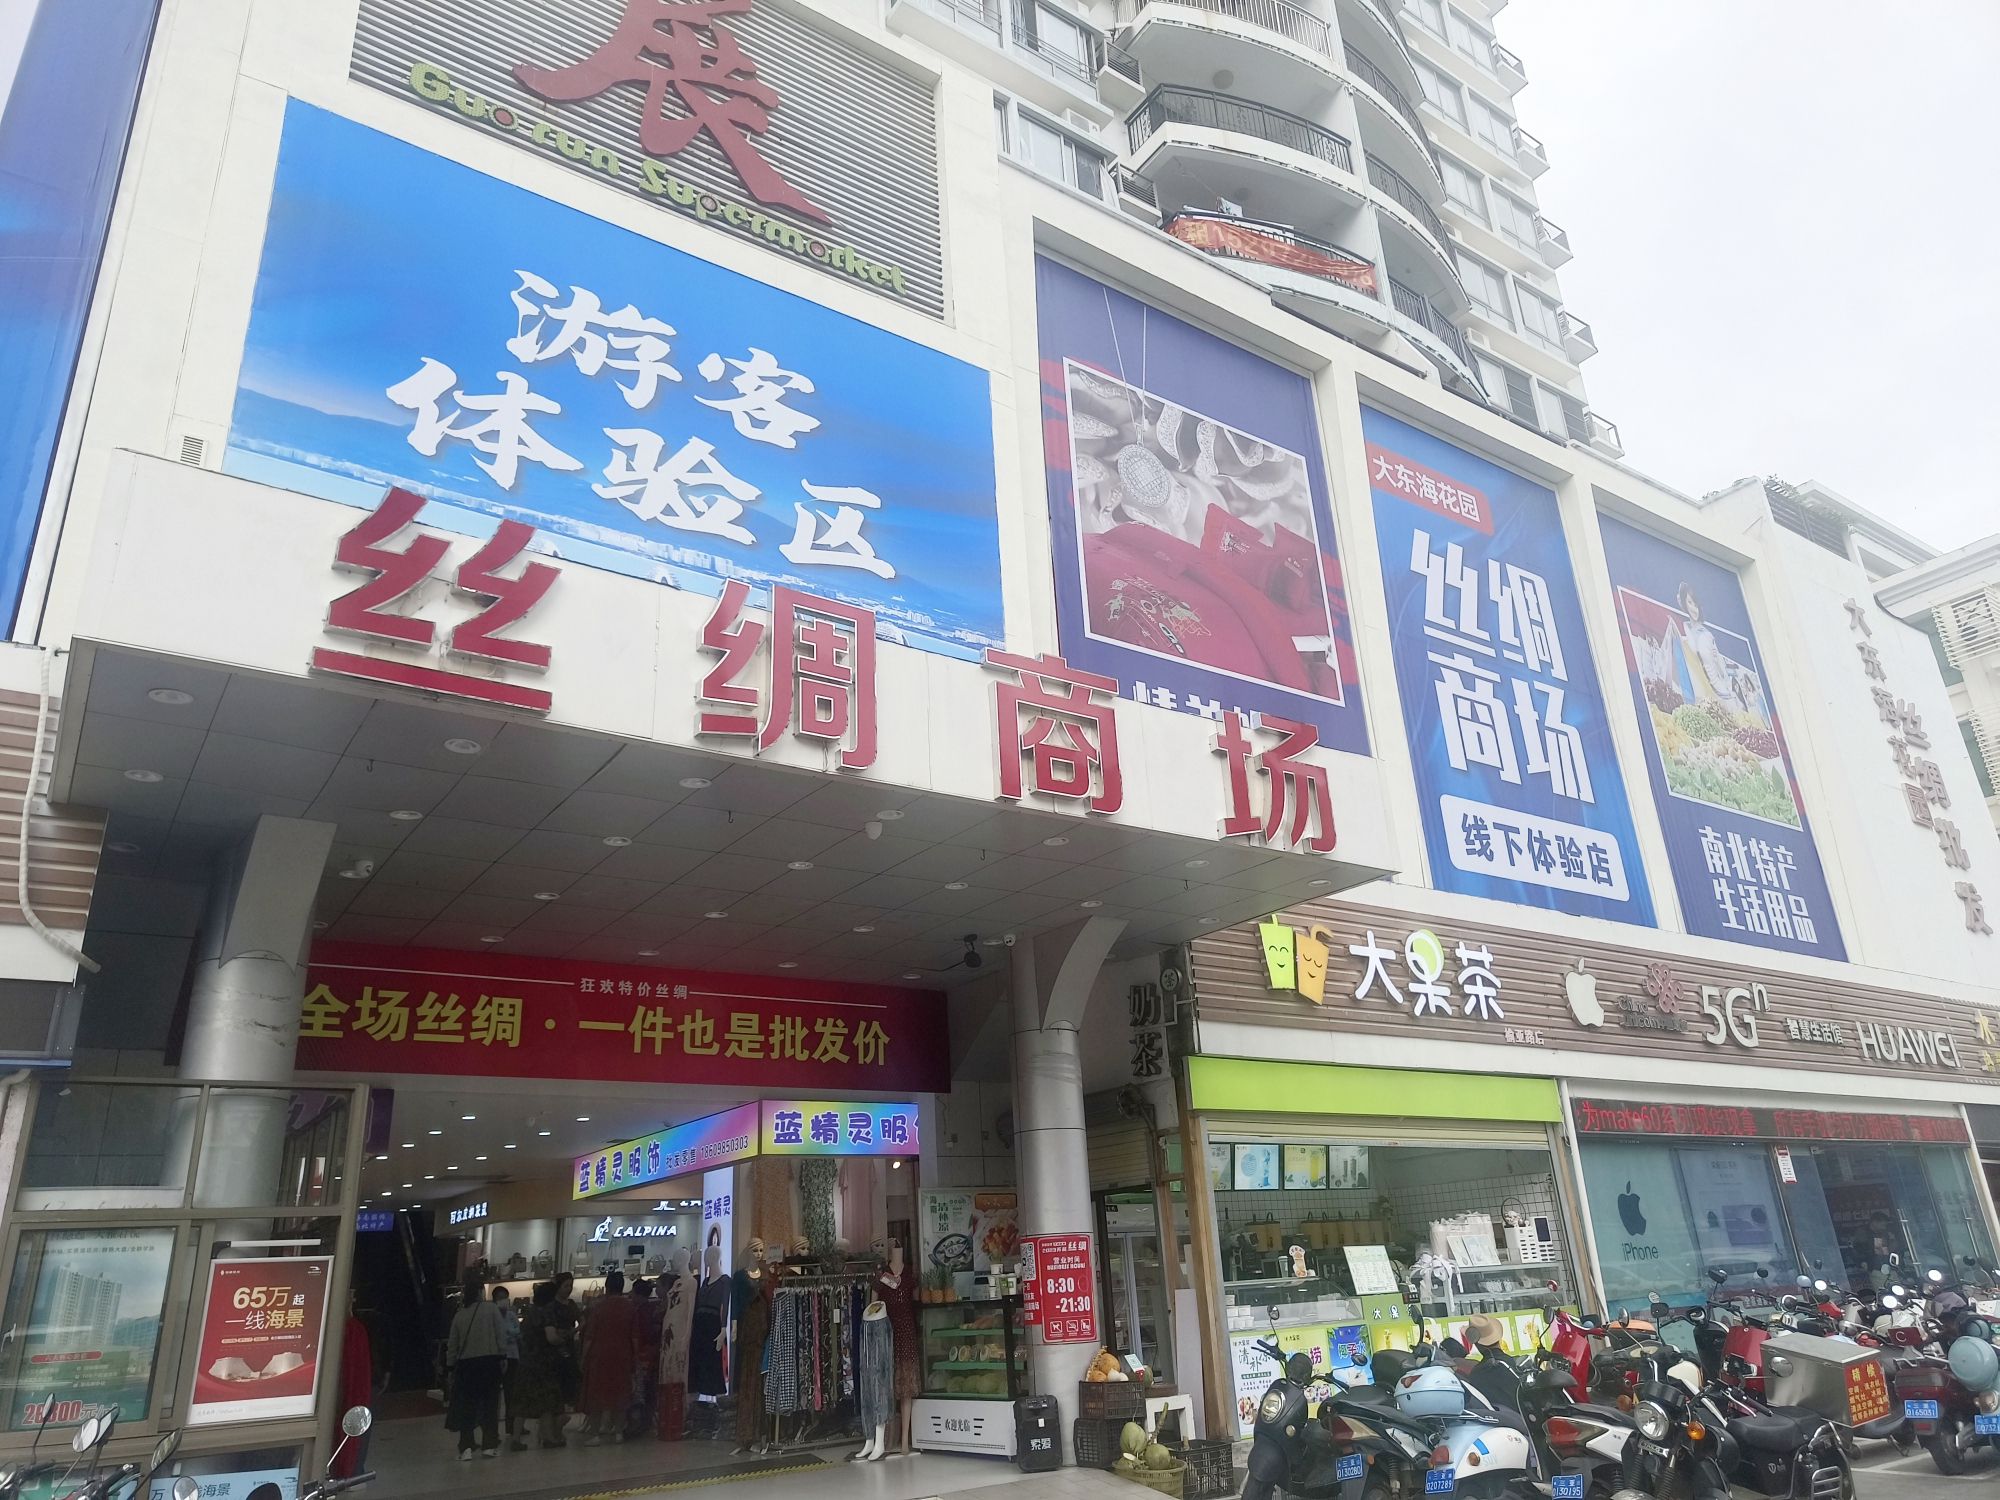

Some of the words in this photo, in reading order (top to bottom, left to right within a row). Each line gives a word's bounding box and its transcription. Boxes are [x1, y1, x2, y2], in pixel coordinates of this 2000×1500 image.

[639, 159, 908, 294] Supermarket
[507, 269, 822, 449] 游客
[386, 357, 897, 579] 体验区
[1372, 455, 1481, 523] 大东海花园
[1410, 528, 1568, 682] 丝绸
[308, 486, 1337, 854] 丝绸商场
[1427, 650, 1596, 804] 商场
[1460, 812, 1615, 889] 线下体验店
[1698, 825, 1798, 891] 南北特产
[1712, 878, 1819, 945] 生活用品
[579, 976, 689, 1000] 狂欢特价丝绸
[1348, 929, 1505, 1020] 大果茶
[1129, 983, 1162, 1076] 奶茶
[1785, 1017, 1843, 1045] 智慧生活馆
[1856, 1021, 1962, 1068] HUAWEI
[773, 1110, 920, 1146] 蓝精灵服
[578, 1139, 662, 1194] 蓝精灵服饰
[704, 1195, 731, 1221] 蓝精灵
[1621, 1242, 1659, 1261] iPhone
[1047, 1278, 1075, 1293] 8:30
[1056, 1296, 1091, 1313] -21:30
[225, 1308, 305, 1331] 一线海景
[945, 1418, 971, 1432] 欢迎光临
